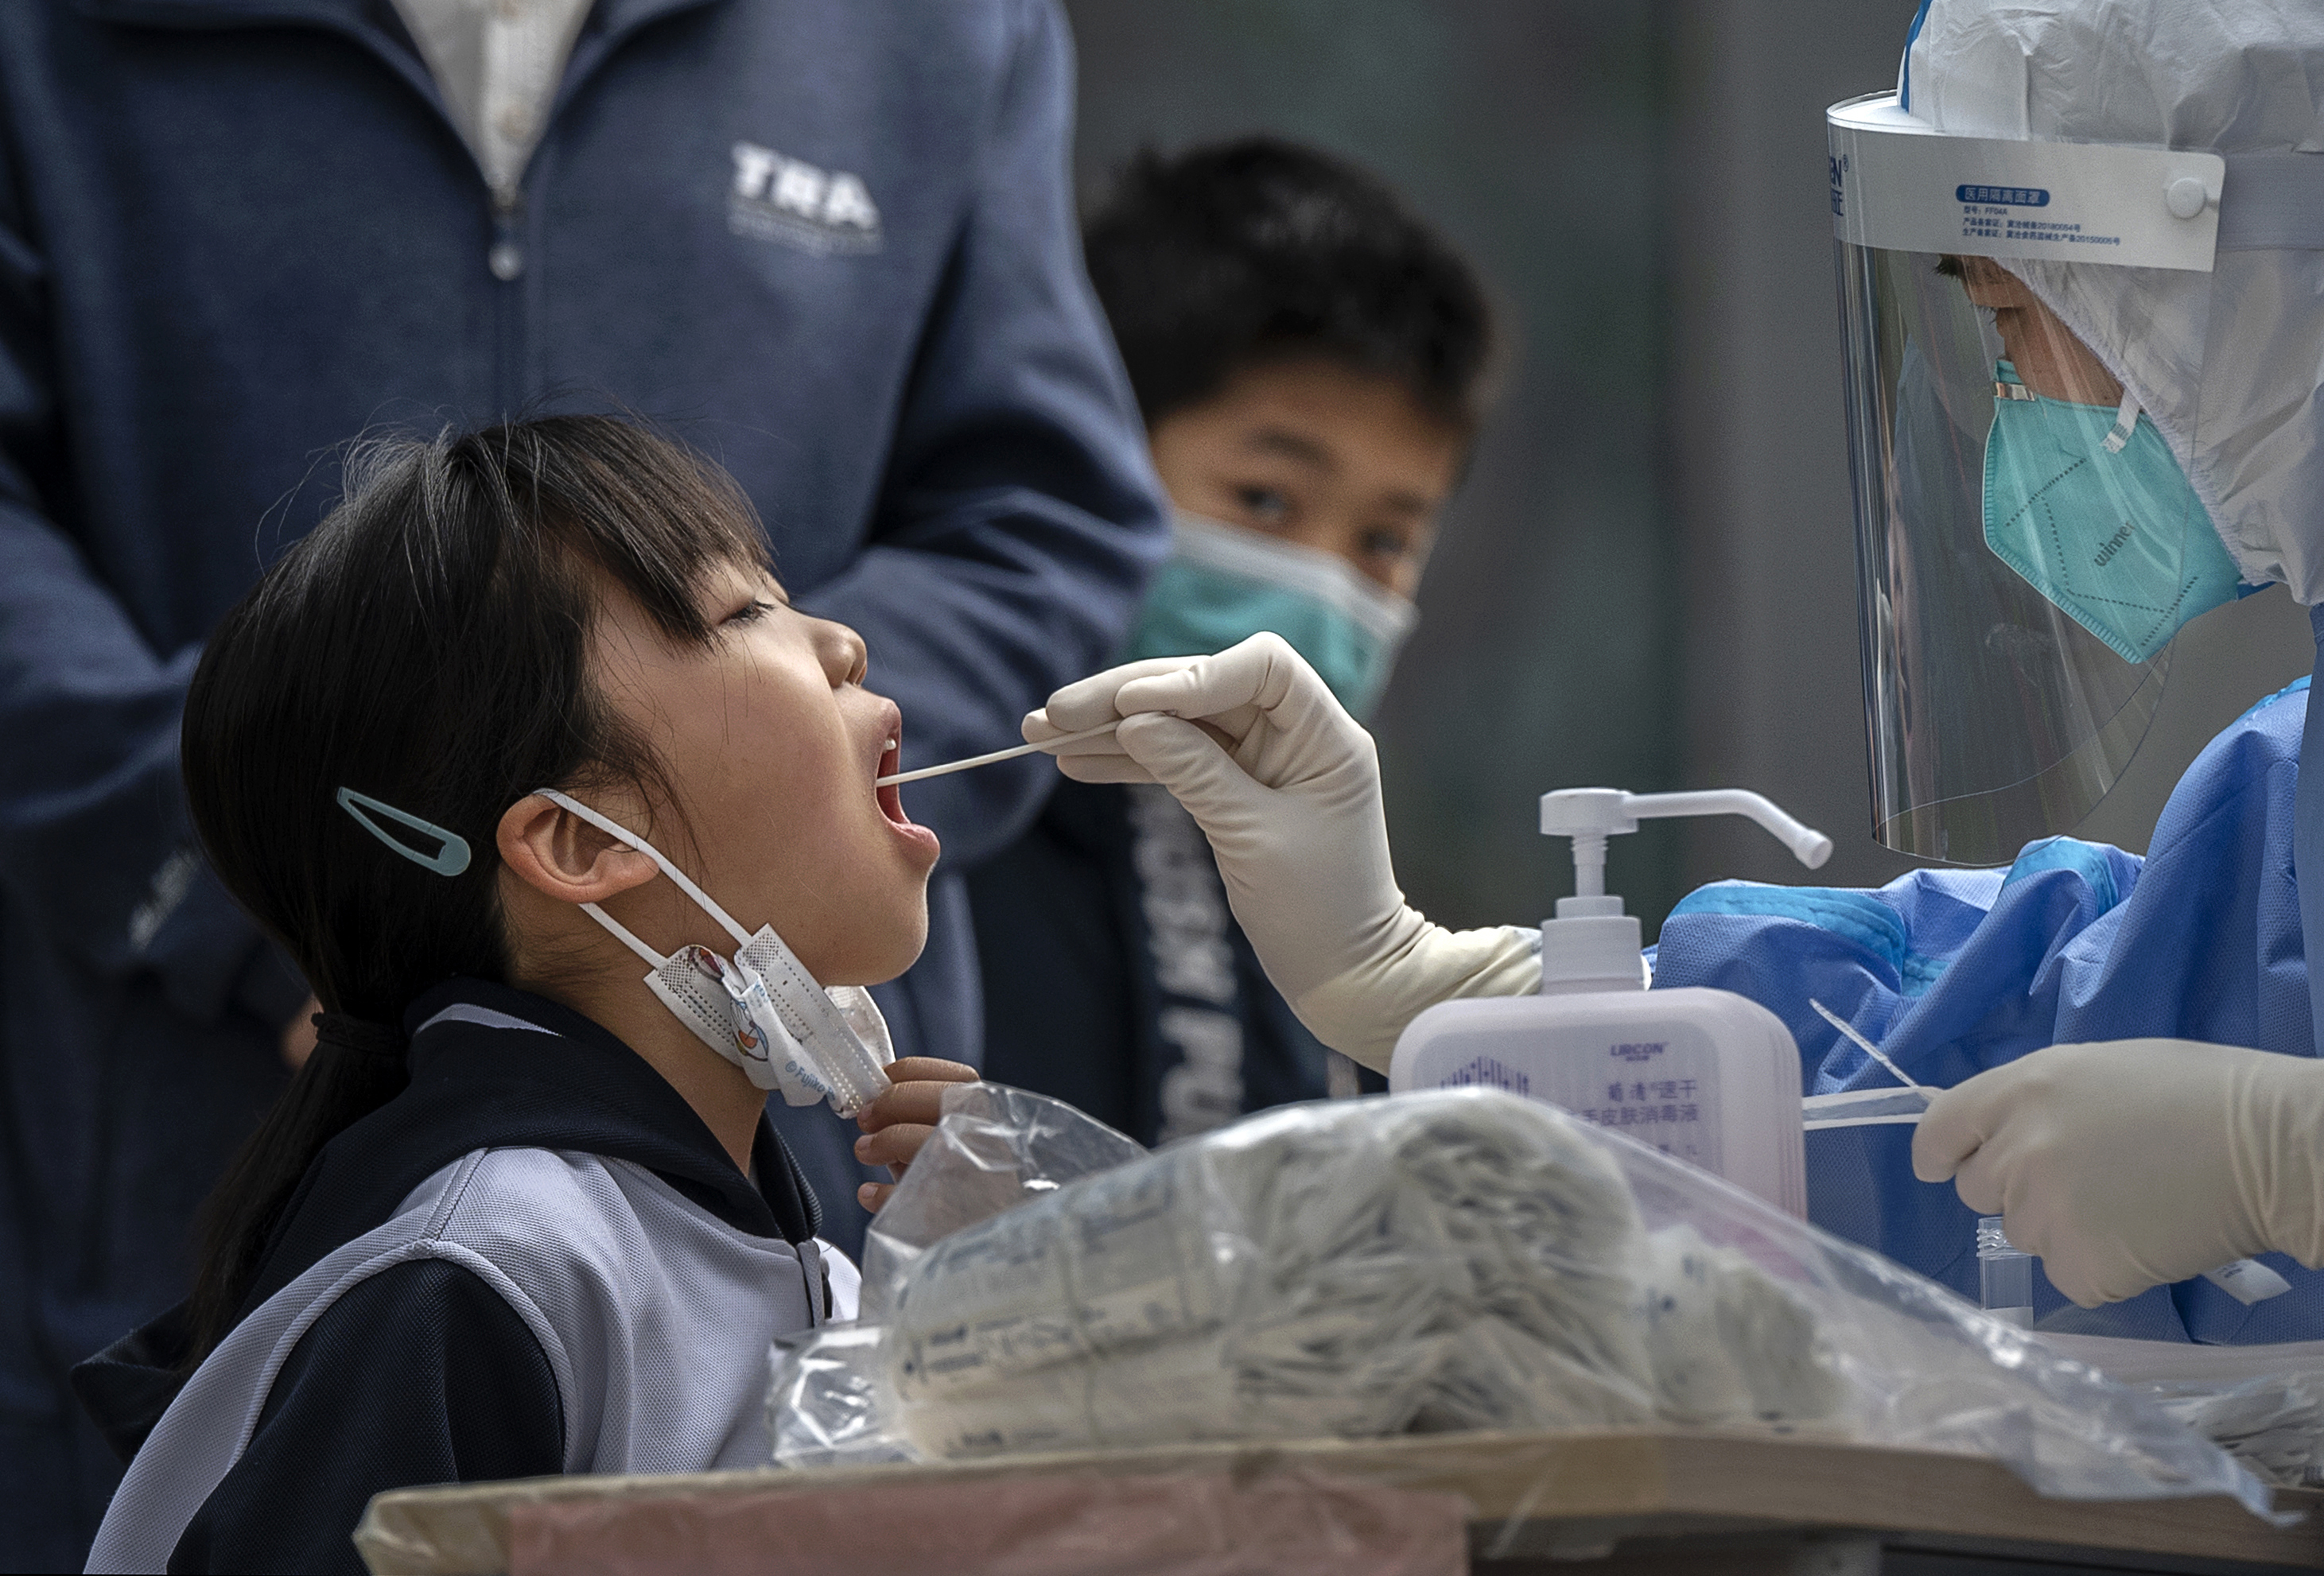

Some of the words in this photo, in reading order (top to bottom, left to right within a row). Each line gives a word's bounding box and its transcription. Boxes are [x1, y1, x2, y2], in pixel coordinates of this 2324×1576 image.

[1965, 187, 2041, 204] 医用隔离面罩
